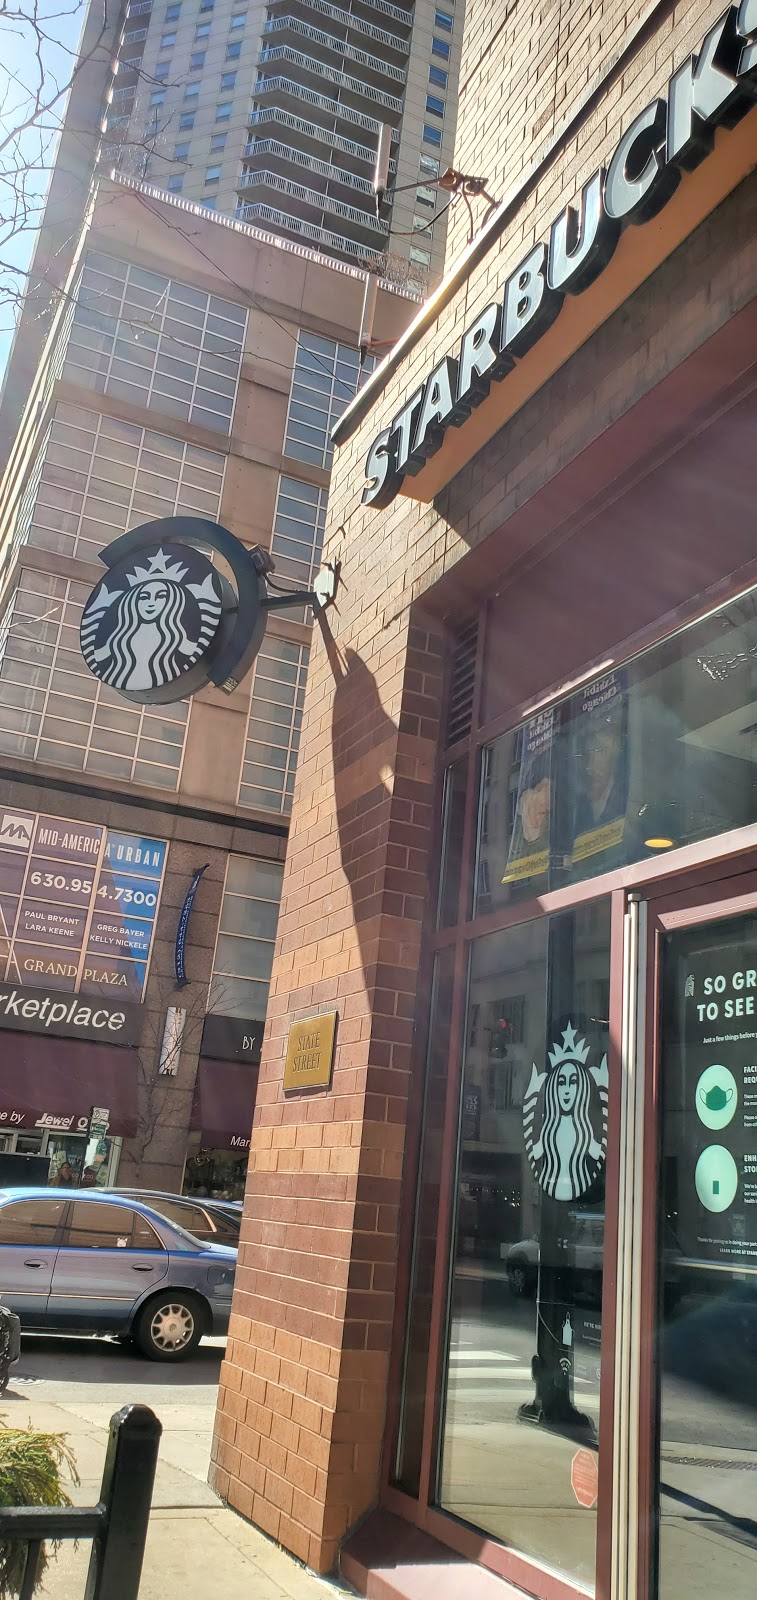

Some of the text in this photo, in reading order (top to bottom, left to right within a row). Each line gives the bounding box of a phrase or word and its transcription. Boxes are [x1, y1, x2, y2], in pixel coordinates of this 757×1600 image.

[116, 844, 161, 867] URBAN
[30, 871, 157, 907] 630.954.7300
[24, 910, 80, 926] PAUL BRYANT
[24, 923, 75, 937] LARA KEENE
[96, 923, 145, 938] GREG BAYER
[89, 934, 148, 950] KELLY NICKELE
[23, 958, 128, 987] GRAND PLAZA
[703, 969, 757, 995] SO GR
[696, 996, 755, 1022] TO SEE
[242, 1036, 256, 1050] BY
[297, 1031, 321, 1052] STATE
[724, 1033, 740, 1042] things
[292, 1052, 322, 1073] STREET
[10, 1110, 25, 1125] by
[35, 1112, 75, 1130] Jewel
[230, 1135, 251, 1148] Mar
